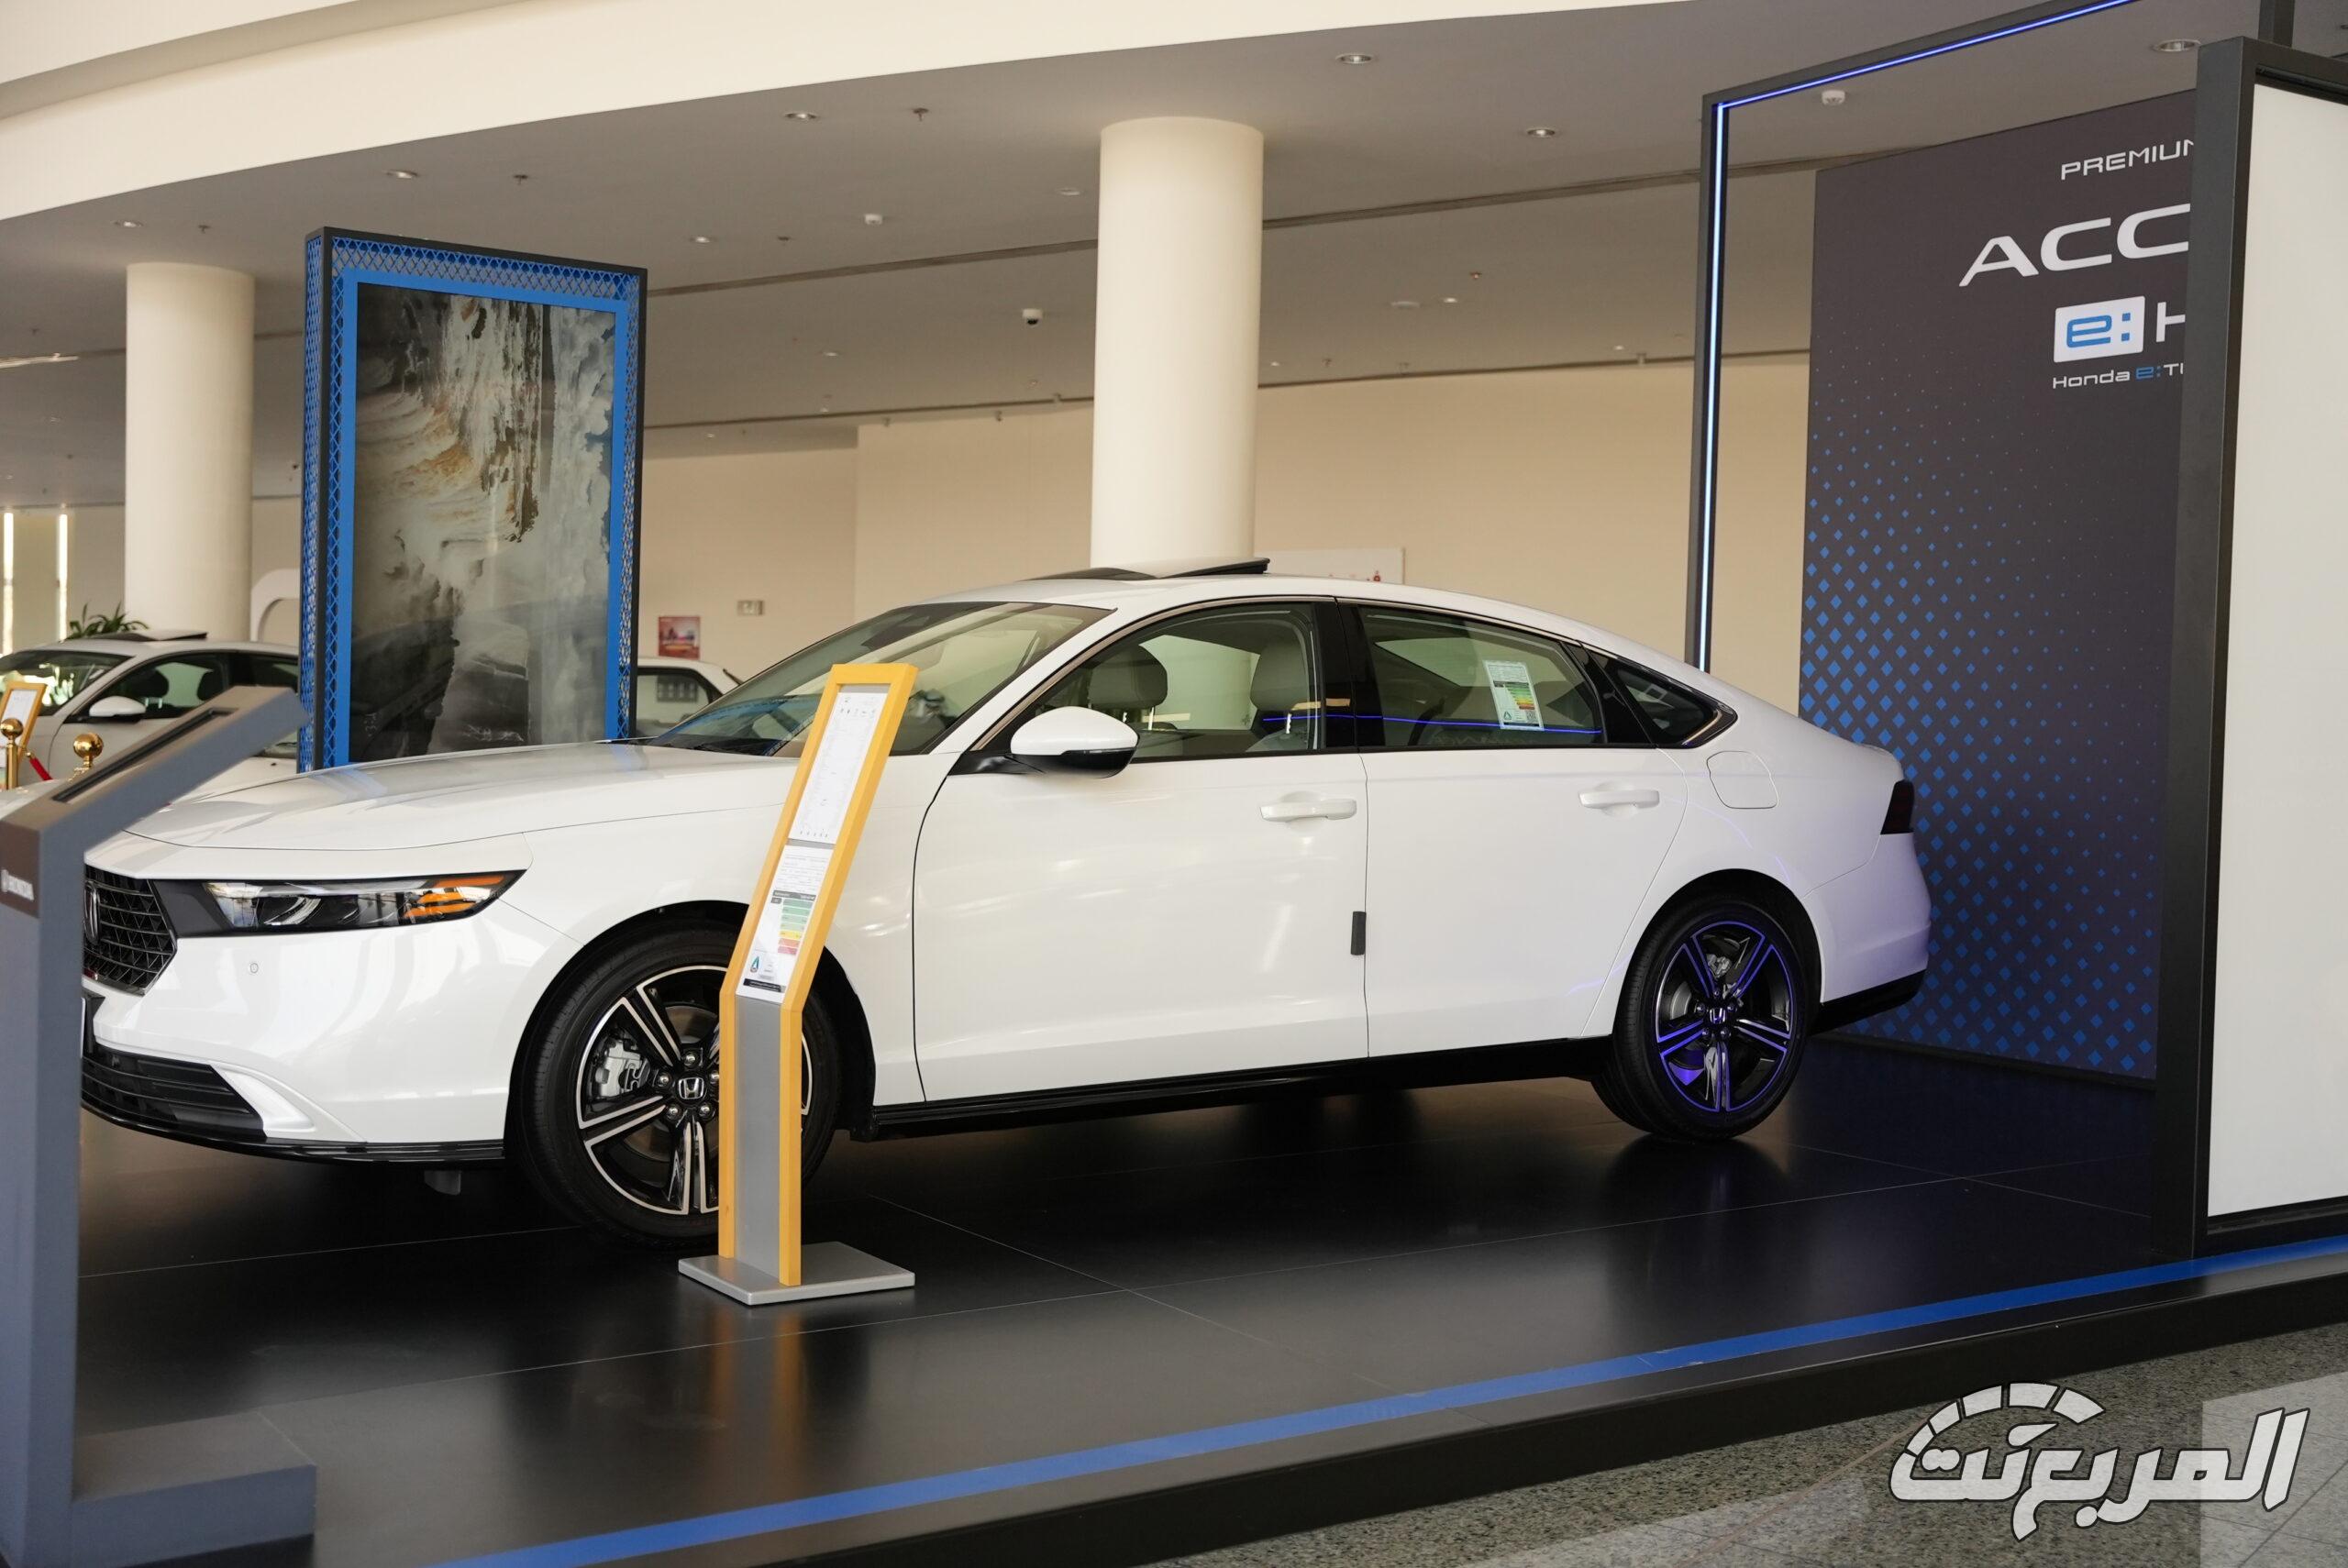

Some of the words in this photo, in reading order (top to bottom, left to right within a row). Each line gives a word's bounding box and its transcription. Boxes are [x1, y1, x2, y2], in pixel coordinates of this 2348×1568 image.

[1958, 203, 2191, 287] ACC
[2053, 370, 2131, 389] Honda
[2135, 362, 2184, 380] e:T
